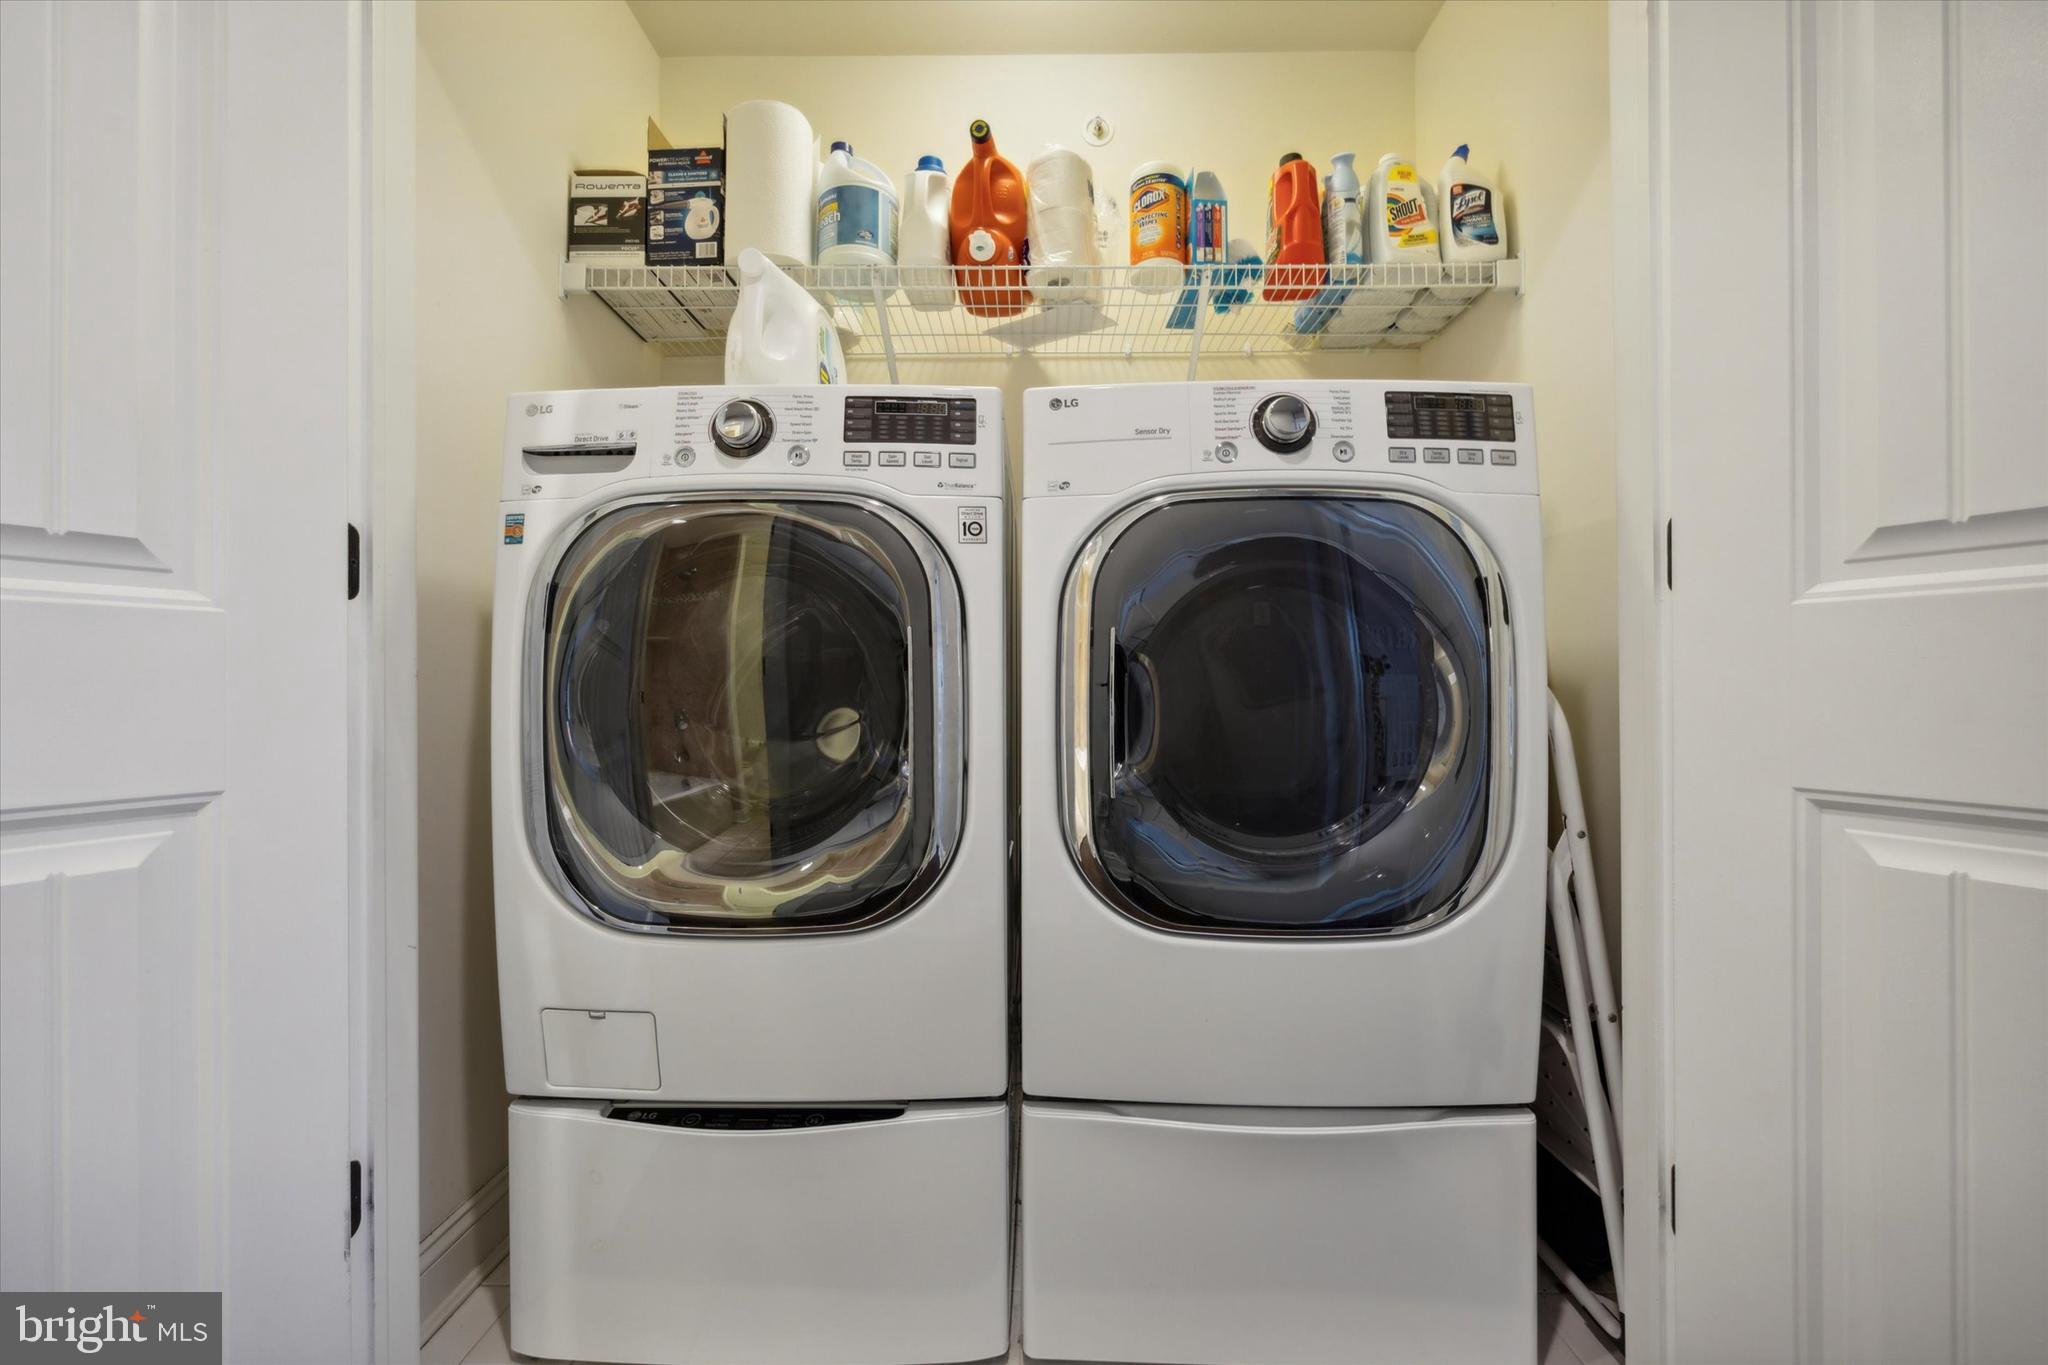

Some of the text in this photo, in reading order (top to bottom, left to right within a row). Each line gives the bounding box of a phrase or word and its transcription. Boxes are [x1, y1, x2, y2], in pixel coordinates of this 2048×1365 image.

[1132, 188, 1166, 213] CLOROX
[1389, 197, 1419, 222] SHOUT
[1063, 398, 1079, 408] LG
[539, 404, 553, 415] LG
[1134, 427, 1171, 436] Sensor Dry
[574, 434, 609, 443] Direct Drive
[962, 521, 983, 537] 10
[642, 1112, 658, 1120] LG
